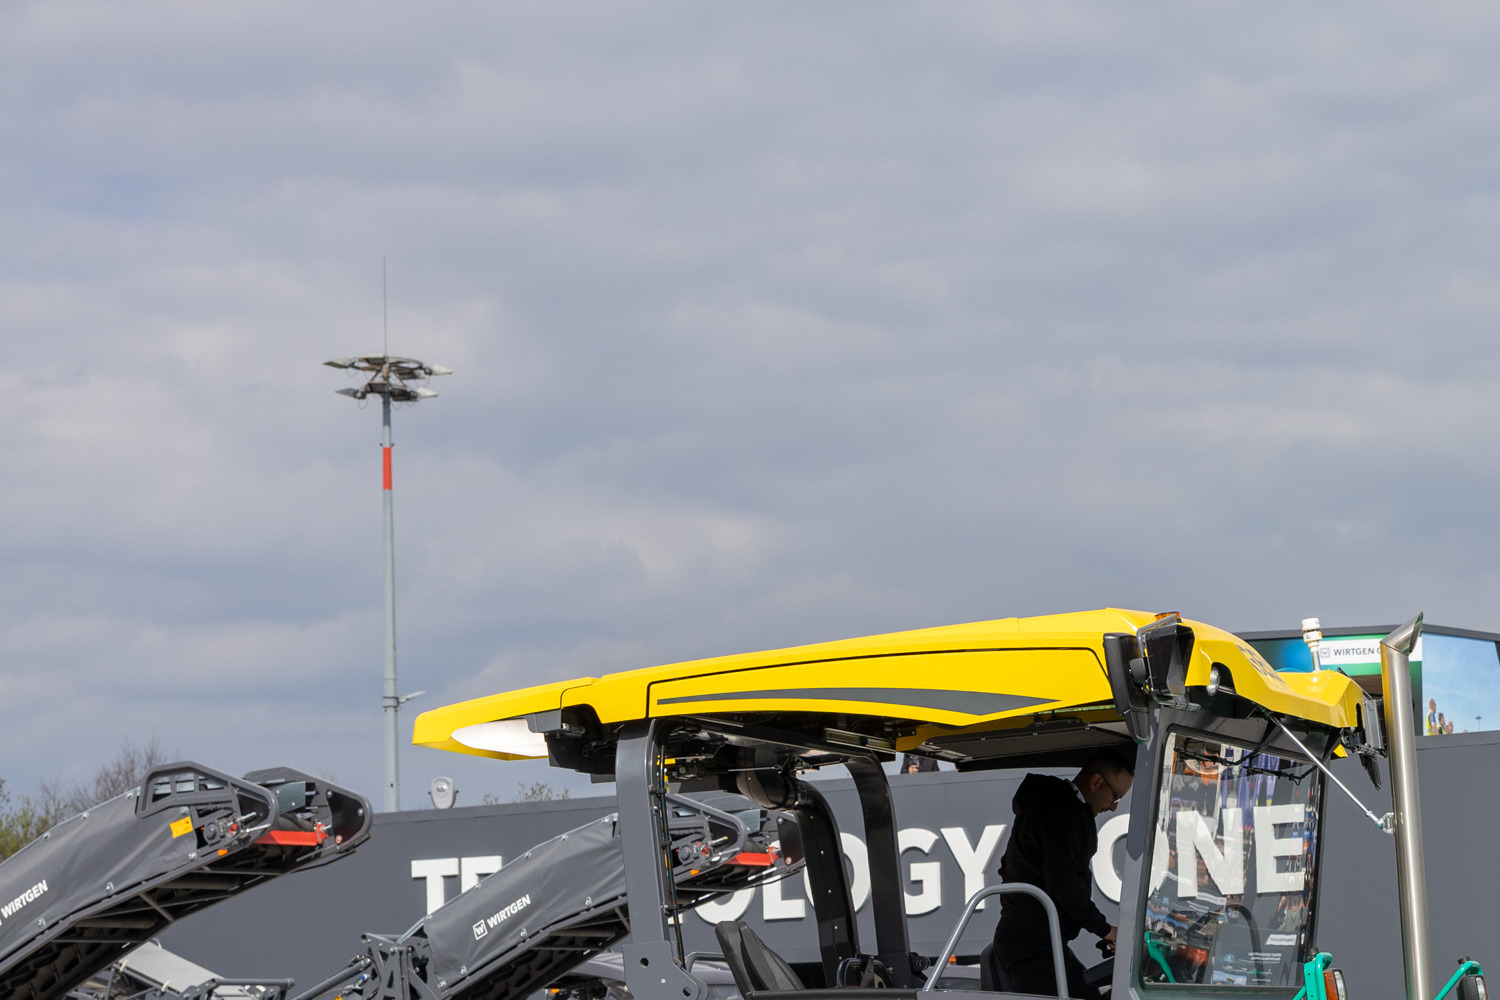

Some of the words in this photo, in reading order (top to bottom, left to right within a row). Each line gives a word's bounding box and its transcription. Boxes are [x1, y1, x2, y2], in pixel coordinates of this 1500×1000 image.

[1333, 647, 1375, 656] WIRTGEN
[1, 879, 49, 919] WIRTGEN
[486, 893, 531, 929] WIRTGEN
